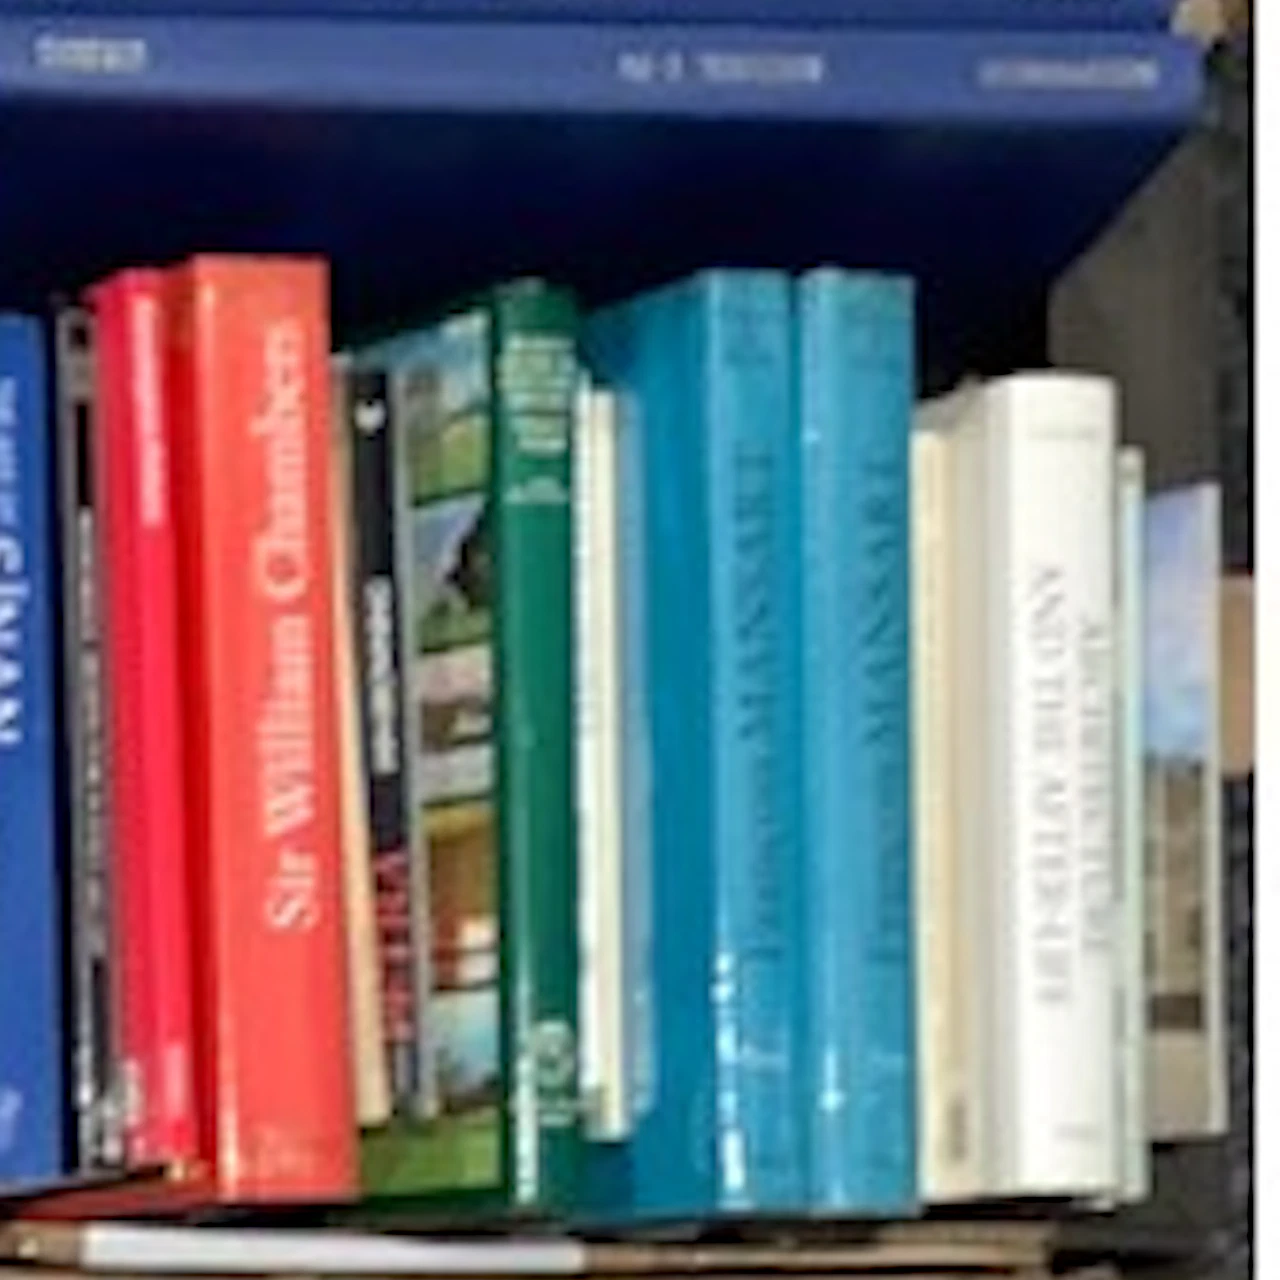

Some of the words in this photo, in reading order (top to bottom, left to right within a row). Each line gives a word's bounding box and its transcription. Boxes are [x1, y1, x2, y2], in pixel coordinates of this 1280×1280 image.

[248, 320, 312, 603] Chambers
[257, 615, 317, 837] William
[265, 845, 319, 930] Sir
